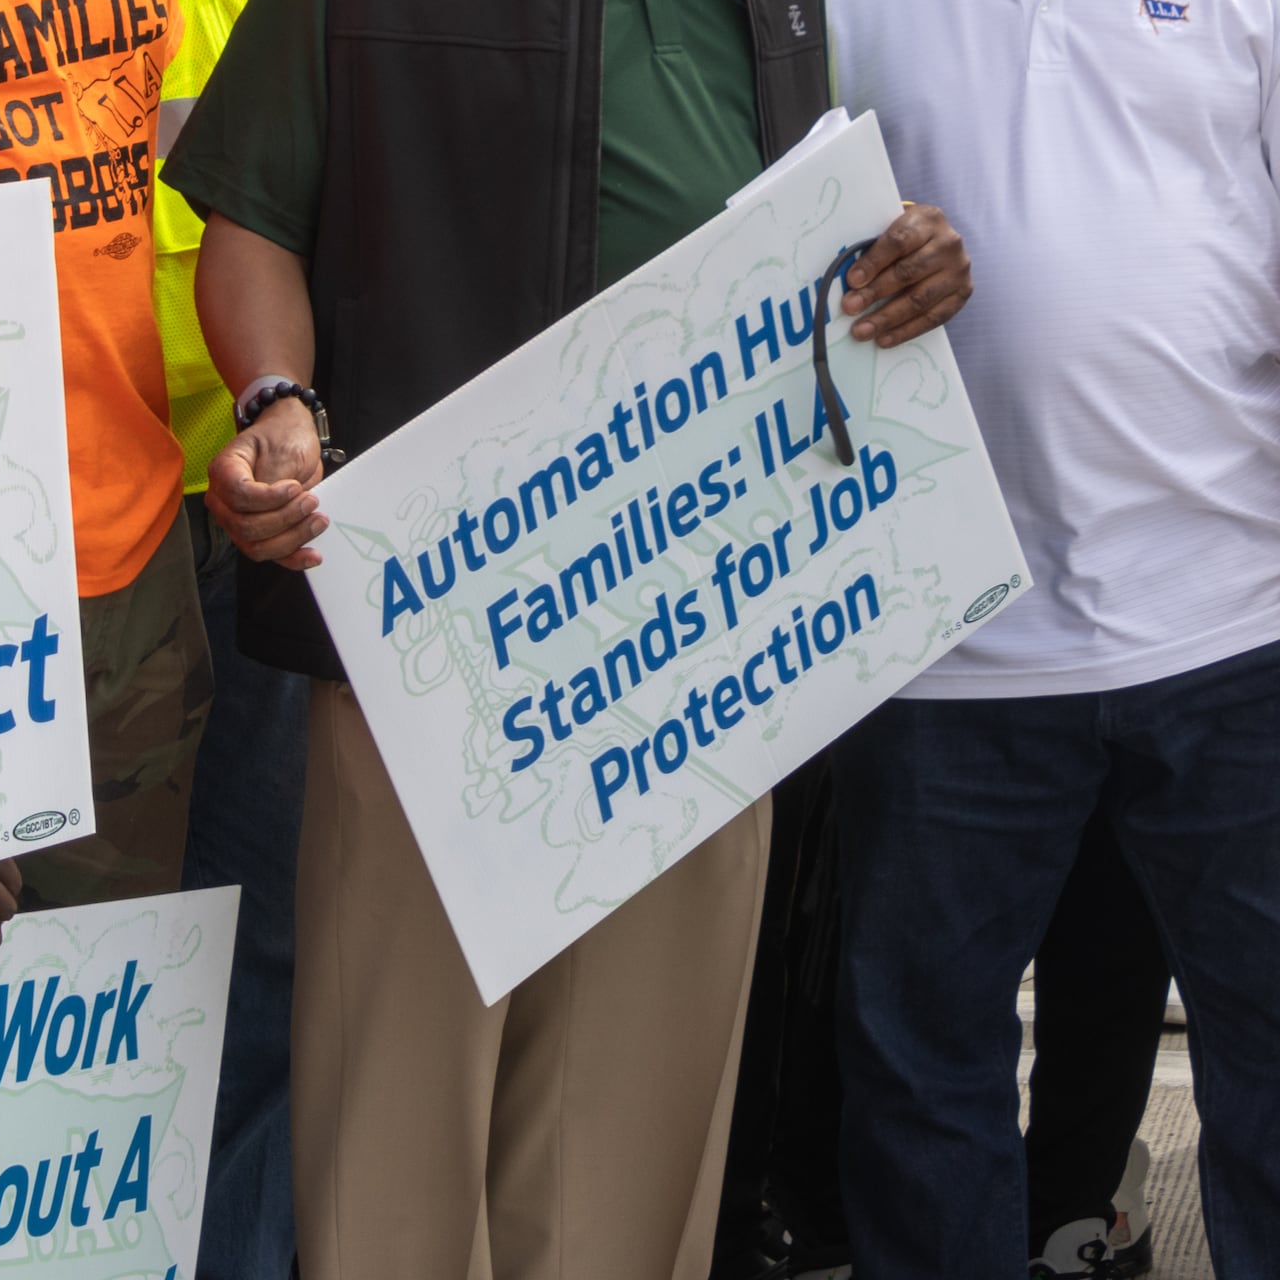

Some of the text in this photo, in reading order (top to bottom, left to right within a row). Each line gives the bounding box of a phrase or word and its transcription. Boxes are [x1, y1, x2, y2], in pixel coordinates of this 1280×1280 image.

[381, 348, 724, 638] Automation
[483, 375, 851, 672] Families: ILA
[502, 445, 897, 774] Stands for Job
[591, 573, 880, 823] Protection
[103, 1115, 152, 1220] A
